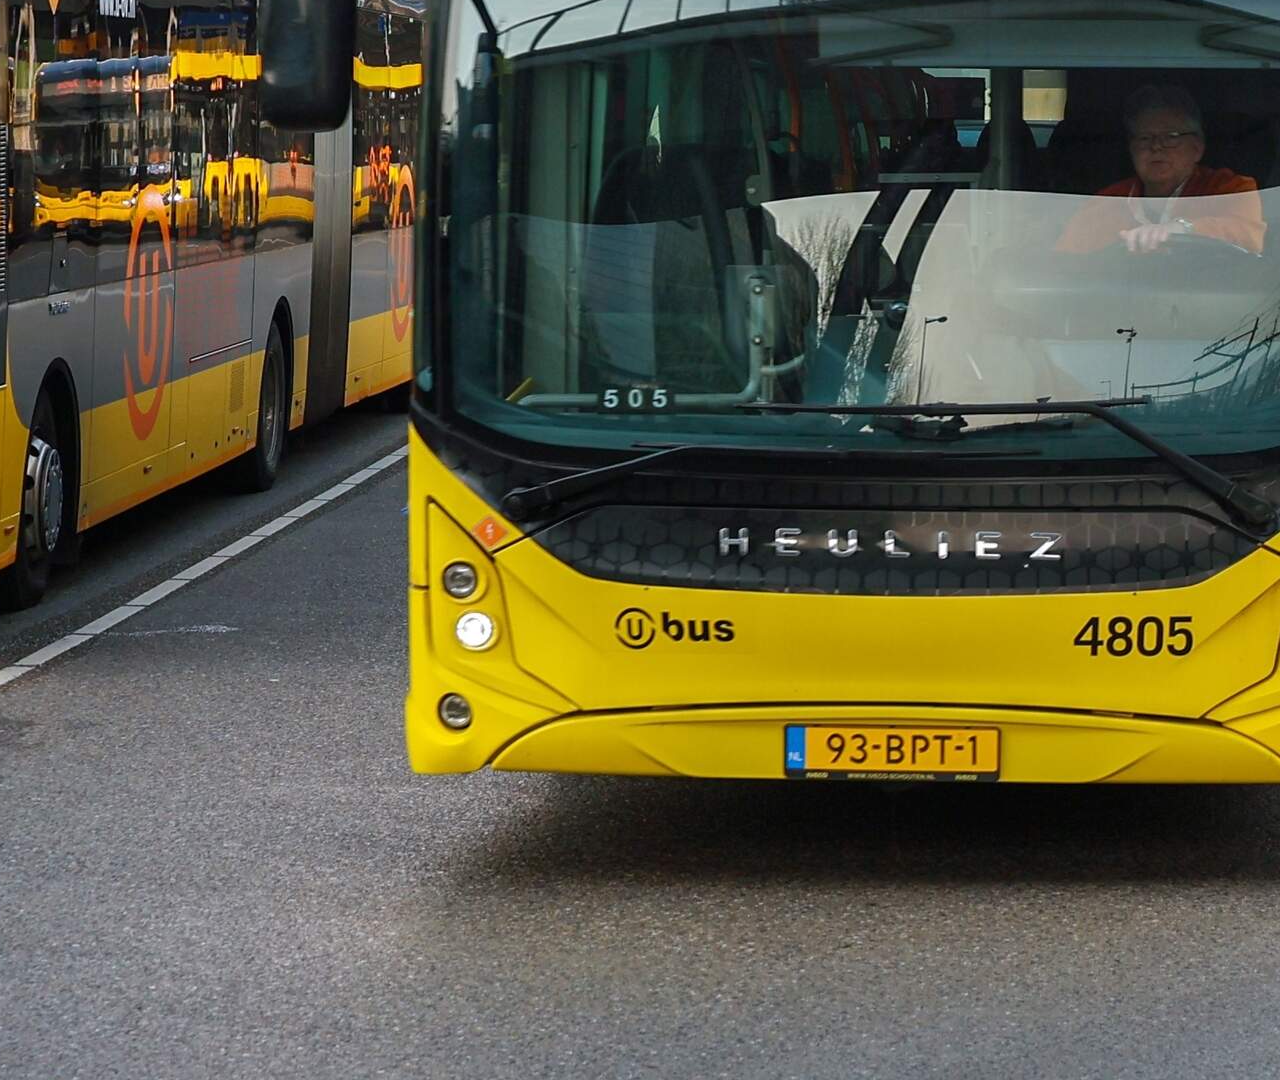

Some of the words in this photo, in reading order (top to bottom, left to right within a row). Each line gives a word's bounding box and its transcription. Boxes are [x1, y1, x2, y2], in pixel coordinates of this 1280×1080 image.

[603, 389, 668, 408] 505
[719, 526, 1065, 560] HEULIEZ
[1073, 616, 1194, 657] 4805
[826, 732, 978, 766] 93-BPT-1
